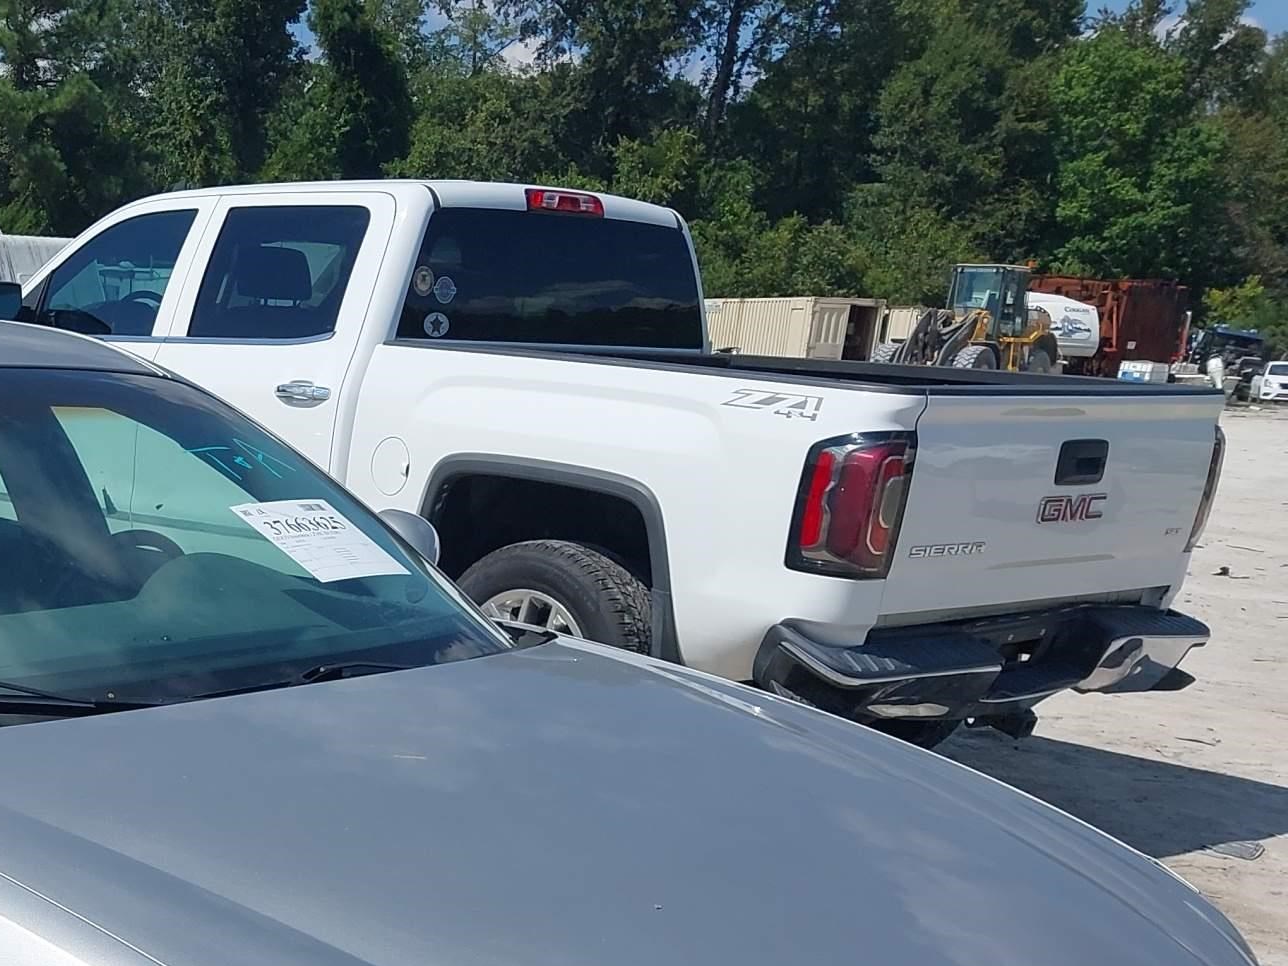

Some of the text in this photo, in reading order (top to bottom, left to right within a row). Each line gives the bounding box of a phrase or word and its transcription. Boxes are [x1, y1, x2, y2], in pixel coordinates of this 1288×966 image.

[1036, 492, 1107, 524] GMC
[263, 516, 346, 536] 37663625
[908, 541, 986, 558] SIERRA
